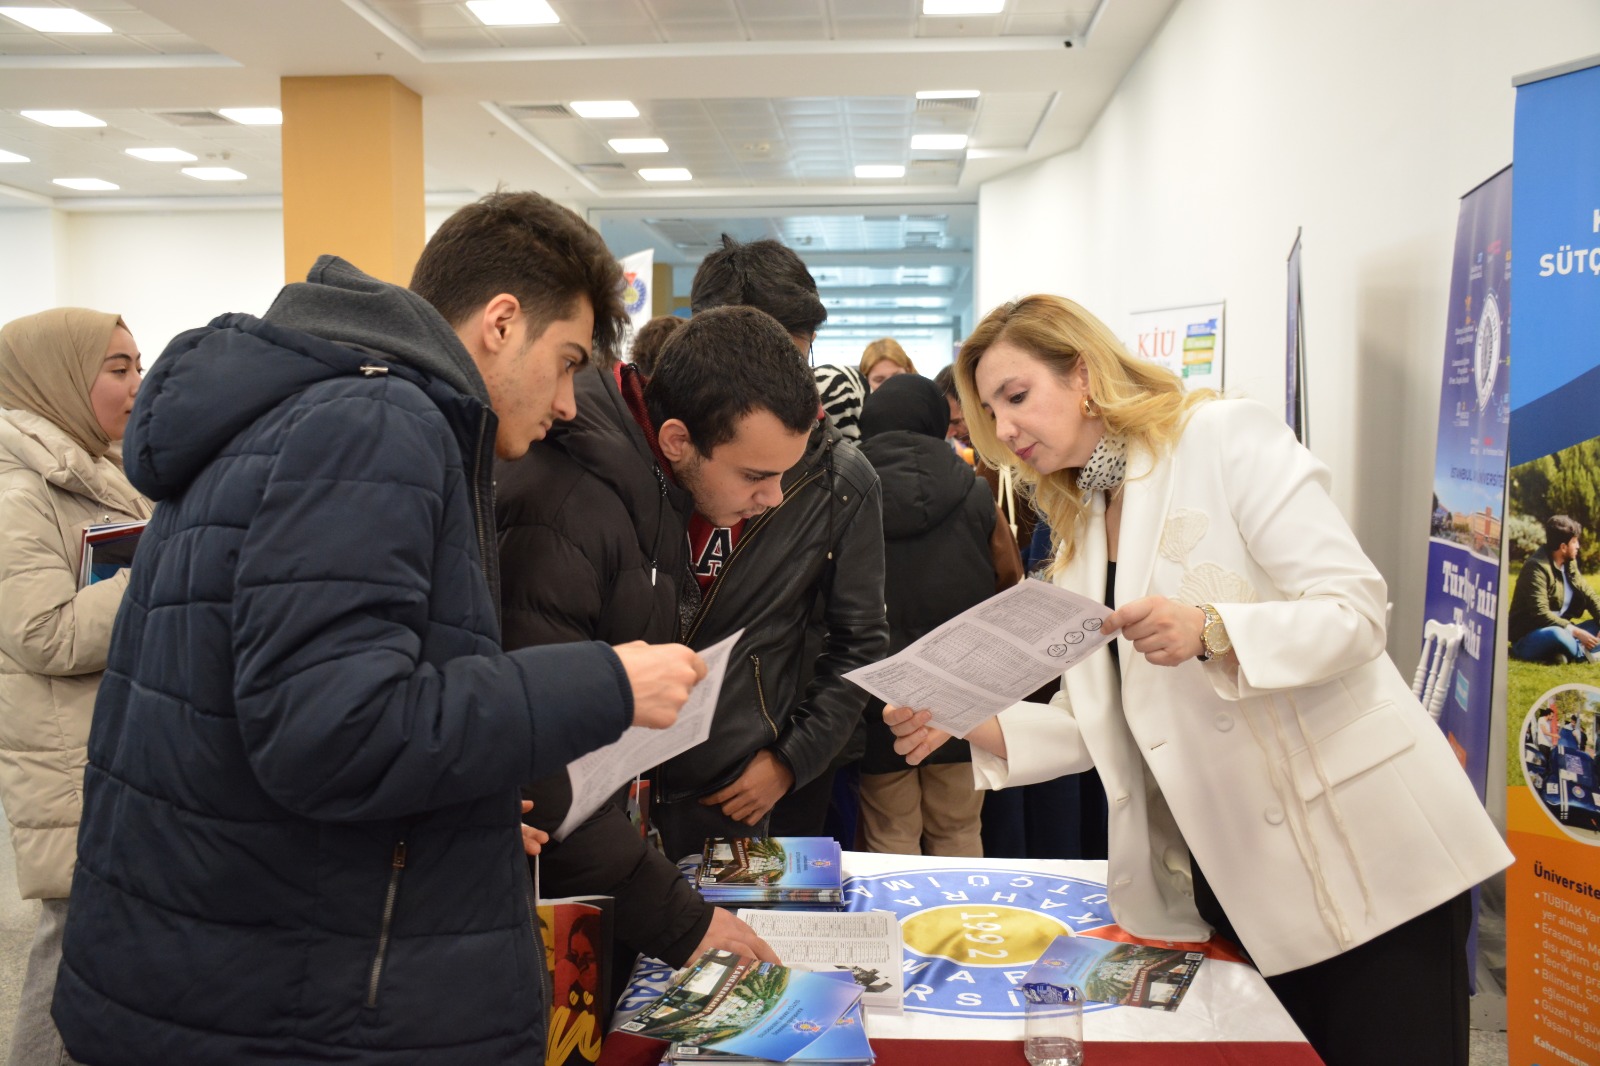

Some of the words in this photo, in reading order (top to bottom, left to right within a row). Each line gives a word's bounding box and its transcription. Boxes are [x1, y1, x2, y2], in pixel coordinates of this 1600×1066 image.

[1542, 891, 1583, 917] TÜBİTAK
[959, 910, 1009, 962] 1992
[1542, 910, 1557, 921] yer
[1558, 916, 1589, 935] almak
[1542, 923, 1585, 951] Erasmus,
[1542, 953, 1569, 974] Teorik
[1571, 969, 1583, 980] ve
[1560, 948, 1590, 968] eğitim
[1542, 969, 1583, 998] Bilimsel,
[1542, 986, 1590, 1015] eğlenmek
[1542, 999, 1568, 1021] Güzel
[1569, 1016, 1581, 1027] ve
[1541, 1013, 1572, 1038] Yaşam
